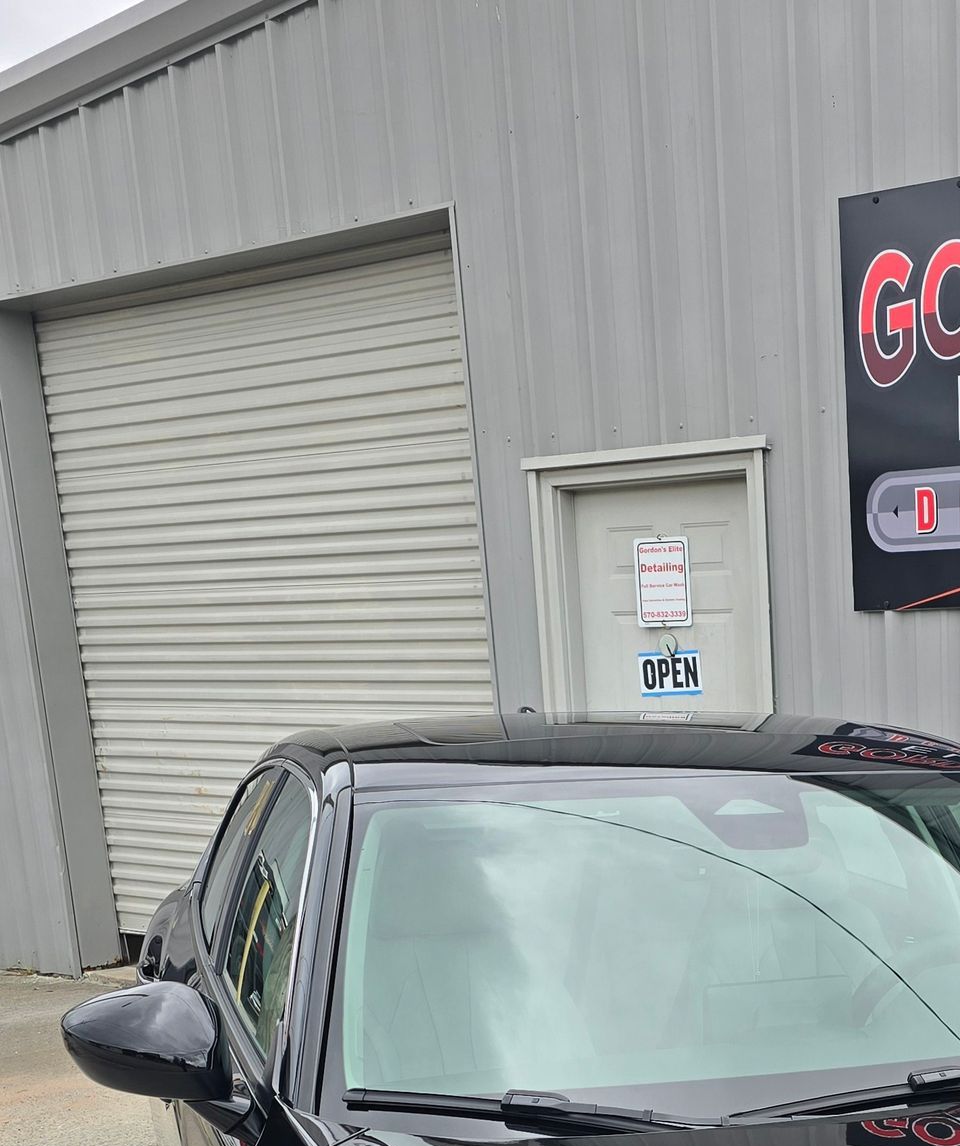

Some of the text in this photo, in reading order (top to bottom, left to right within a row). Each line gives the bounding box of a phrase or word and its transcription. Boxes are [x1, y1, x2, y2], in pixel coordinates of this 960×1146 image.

[668, 545, 683, 553] Elite
[640, 563, 684, 574] Detailing
[642, 657, 699, 690] OPEN
